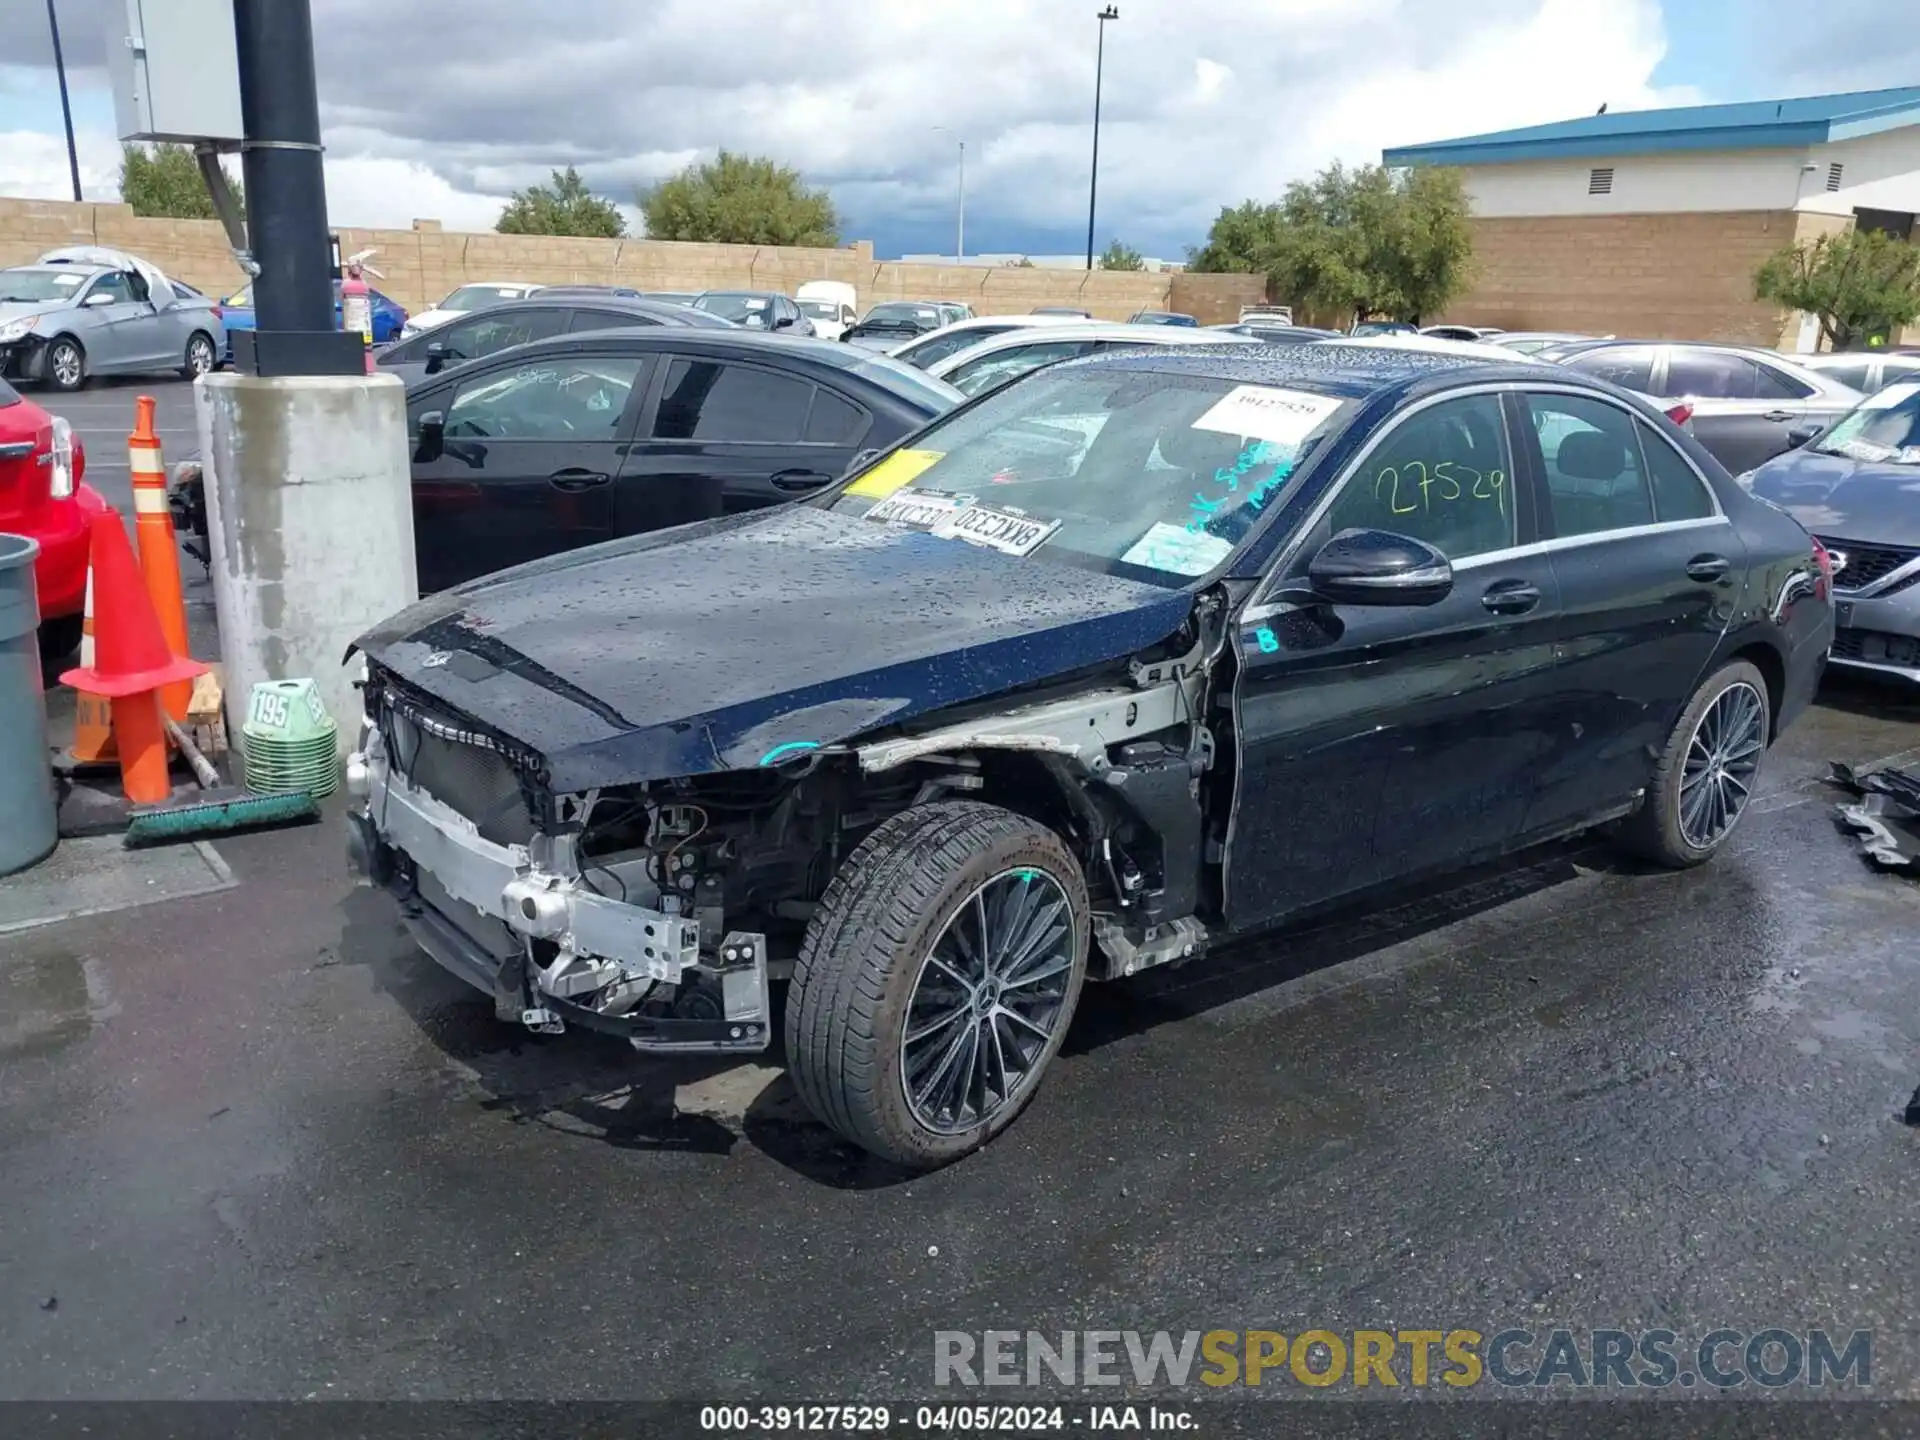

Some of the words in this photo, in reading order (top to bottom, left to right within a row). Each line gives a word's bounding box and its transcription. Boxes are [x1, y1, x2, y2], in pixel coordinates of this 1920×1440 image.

[1375, 460, 1505, 518] 27529
[1256, 627, 1279, 653] B
[254, 689, 290, 729] 195
